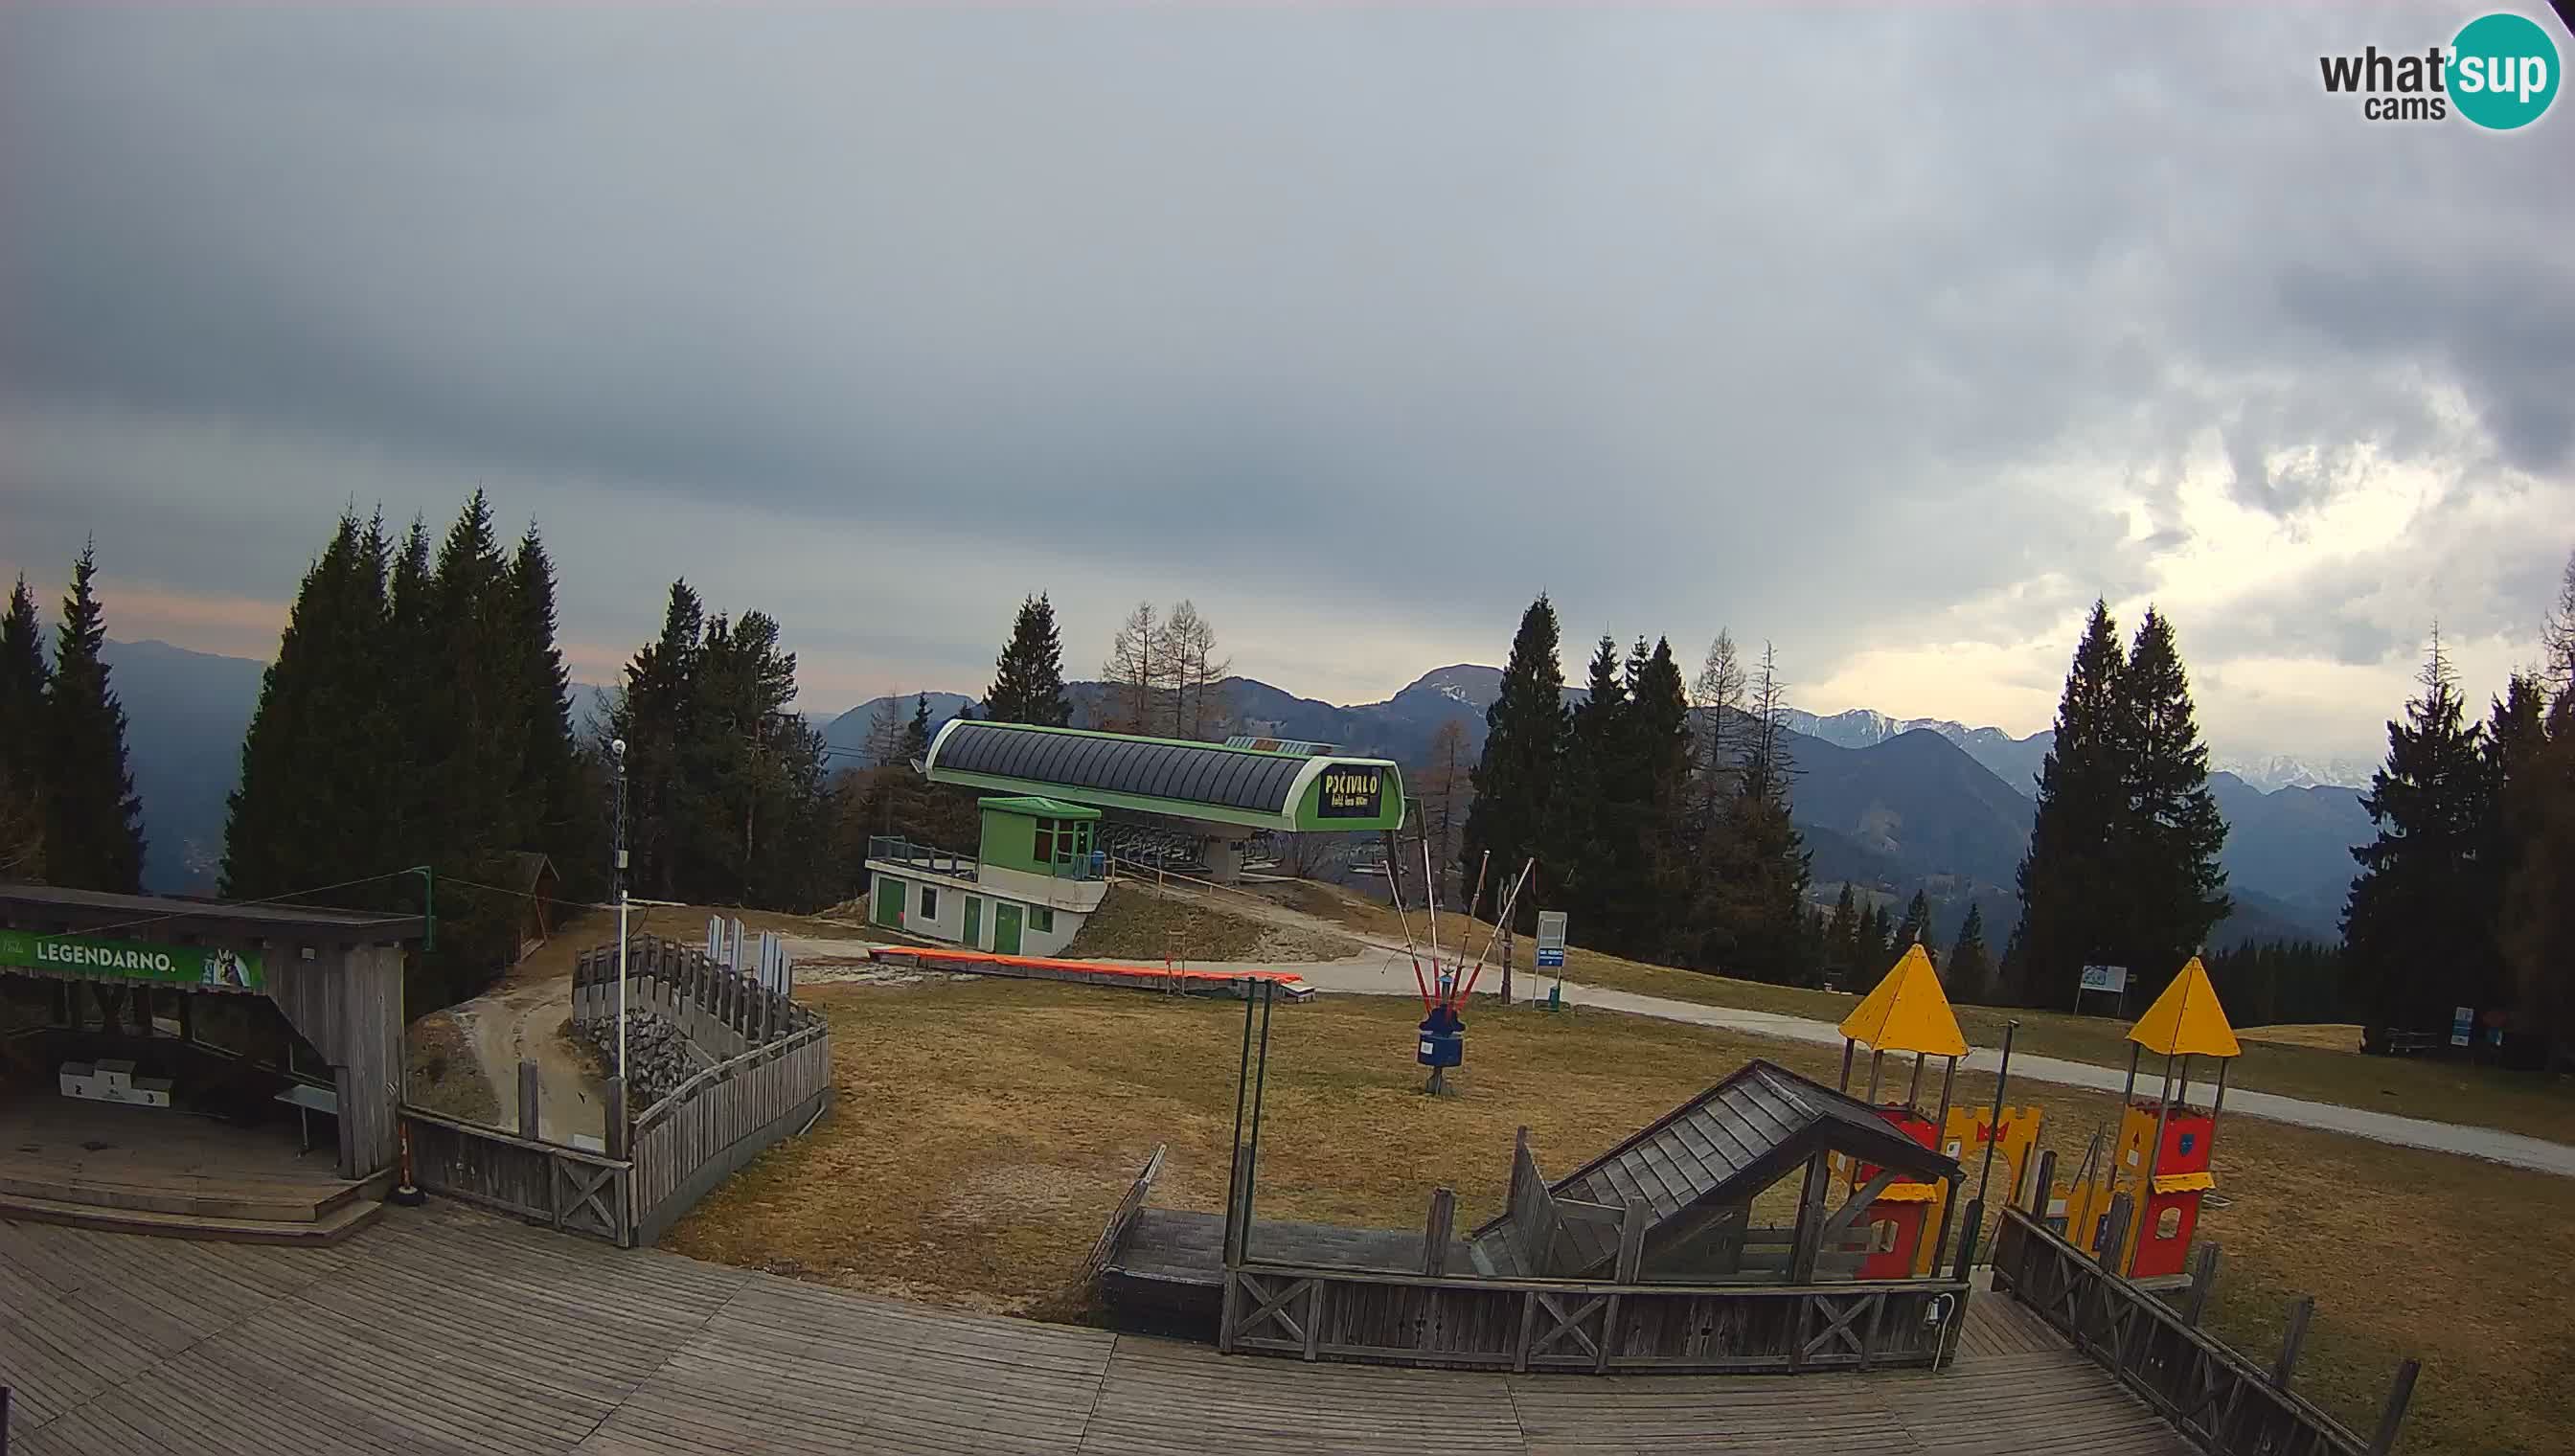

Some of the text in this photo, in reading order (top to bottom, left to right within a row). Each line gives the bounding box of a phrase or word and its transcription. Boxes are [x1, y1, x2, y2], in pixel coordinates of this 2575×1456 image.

[35, 942, 176, 972] LEGENDARNO.
[109, 1075, 115, 1085] 1
[75, 1084, 82, 1095] 2
